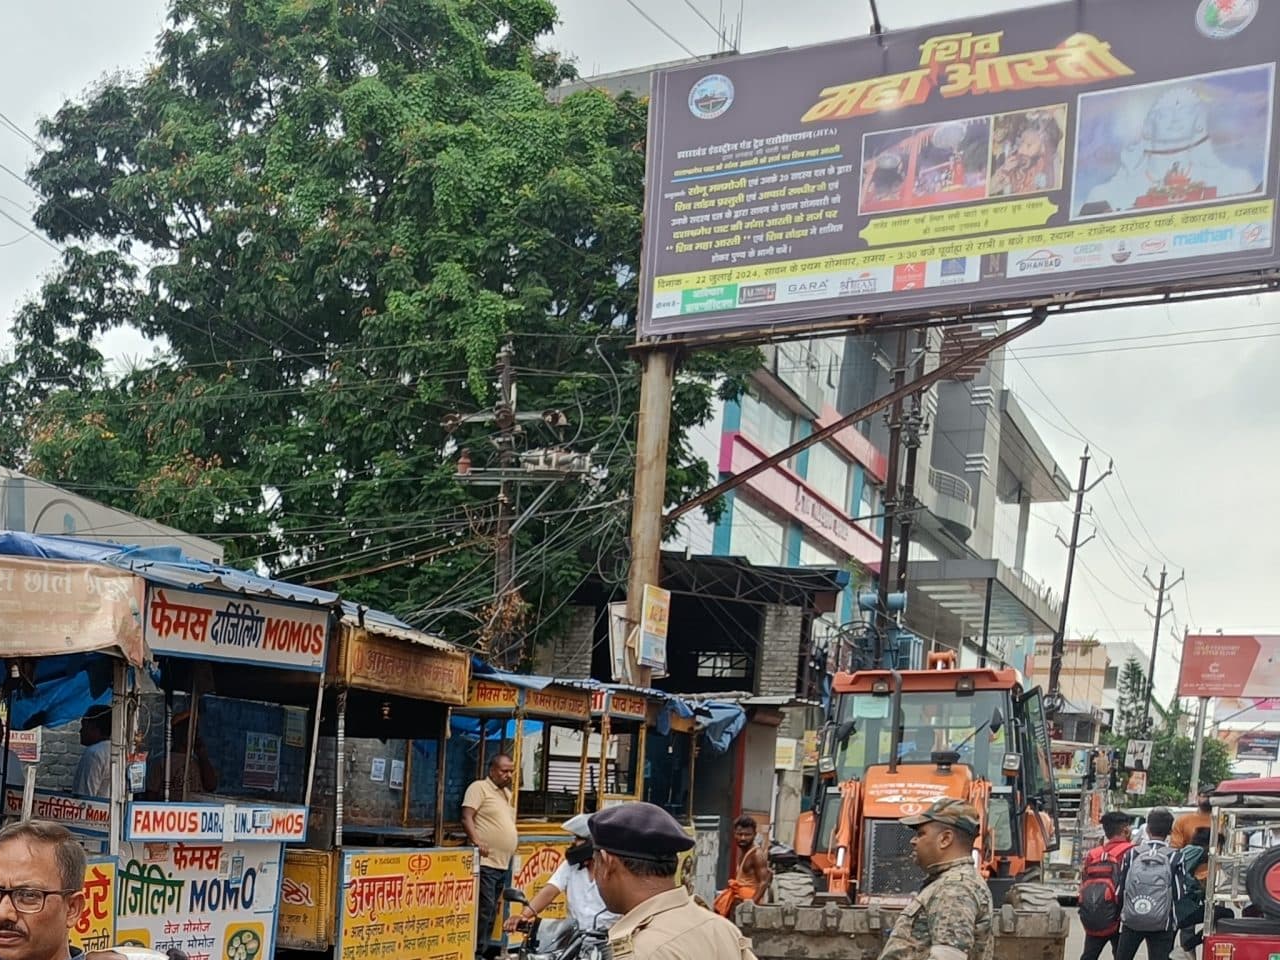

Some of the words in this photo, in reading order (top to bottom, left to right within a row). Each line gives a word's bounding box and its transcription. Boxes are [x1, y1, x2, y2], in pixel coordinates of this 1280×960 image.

[919, 31, 1004, 65] शिव
[801, 68, 933, 122] महा
[940, 32, 1135, 97] आरती
[151, 590, 212, 642] फेमस
[211, 601, 266, 648] दार्जिलिंग
[262, 617, 323, 655] MOMOS
[134, 810, 198, 833] FAMOUS
[173, 842, 223, 871] फेमस
[189, 867, 257, 912] MOMO
[347, 875, 405, 921] अमृतसर
[164, 921, 180, 934] वेज
[183, 918, 211, 933] मोमोज
[187, 935, 216, 950] मोमोज
